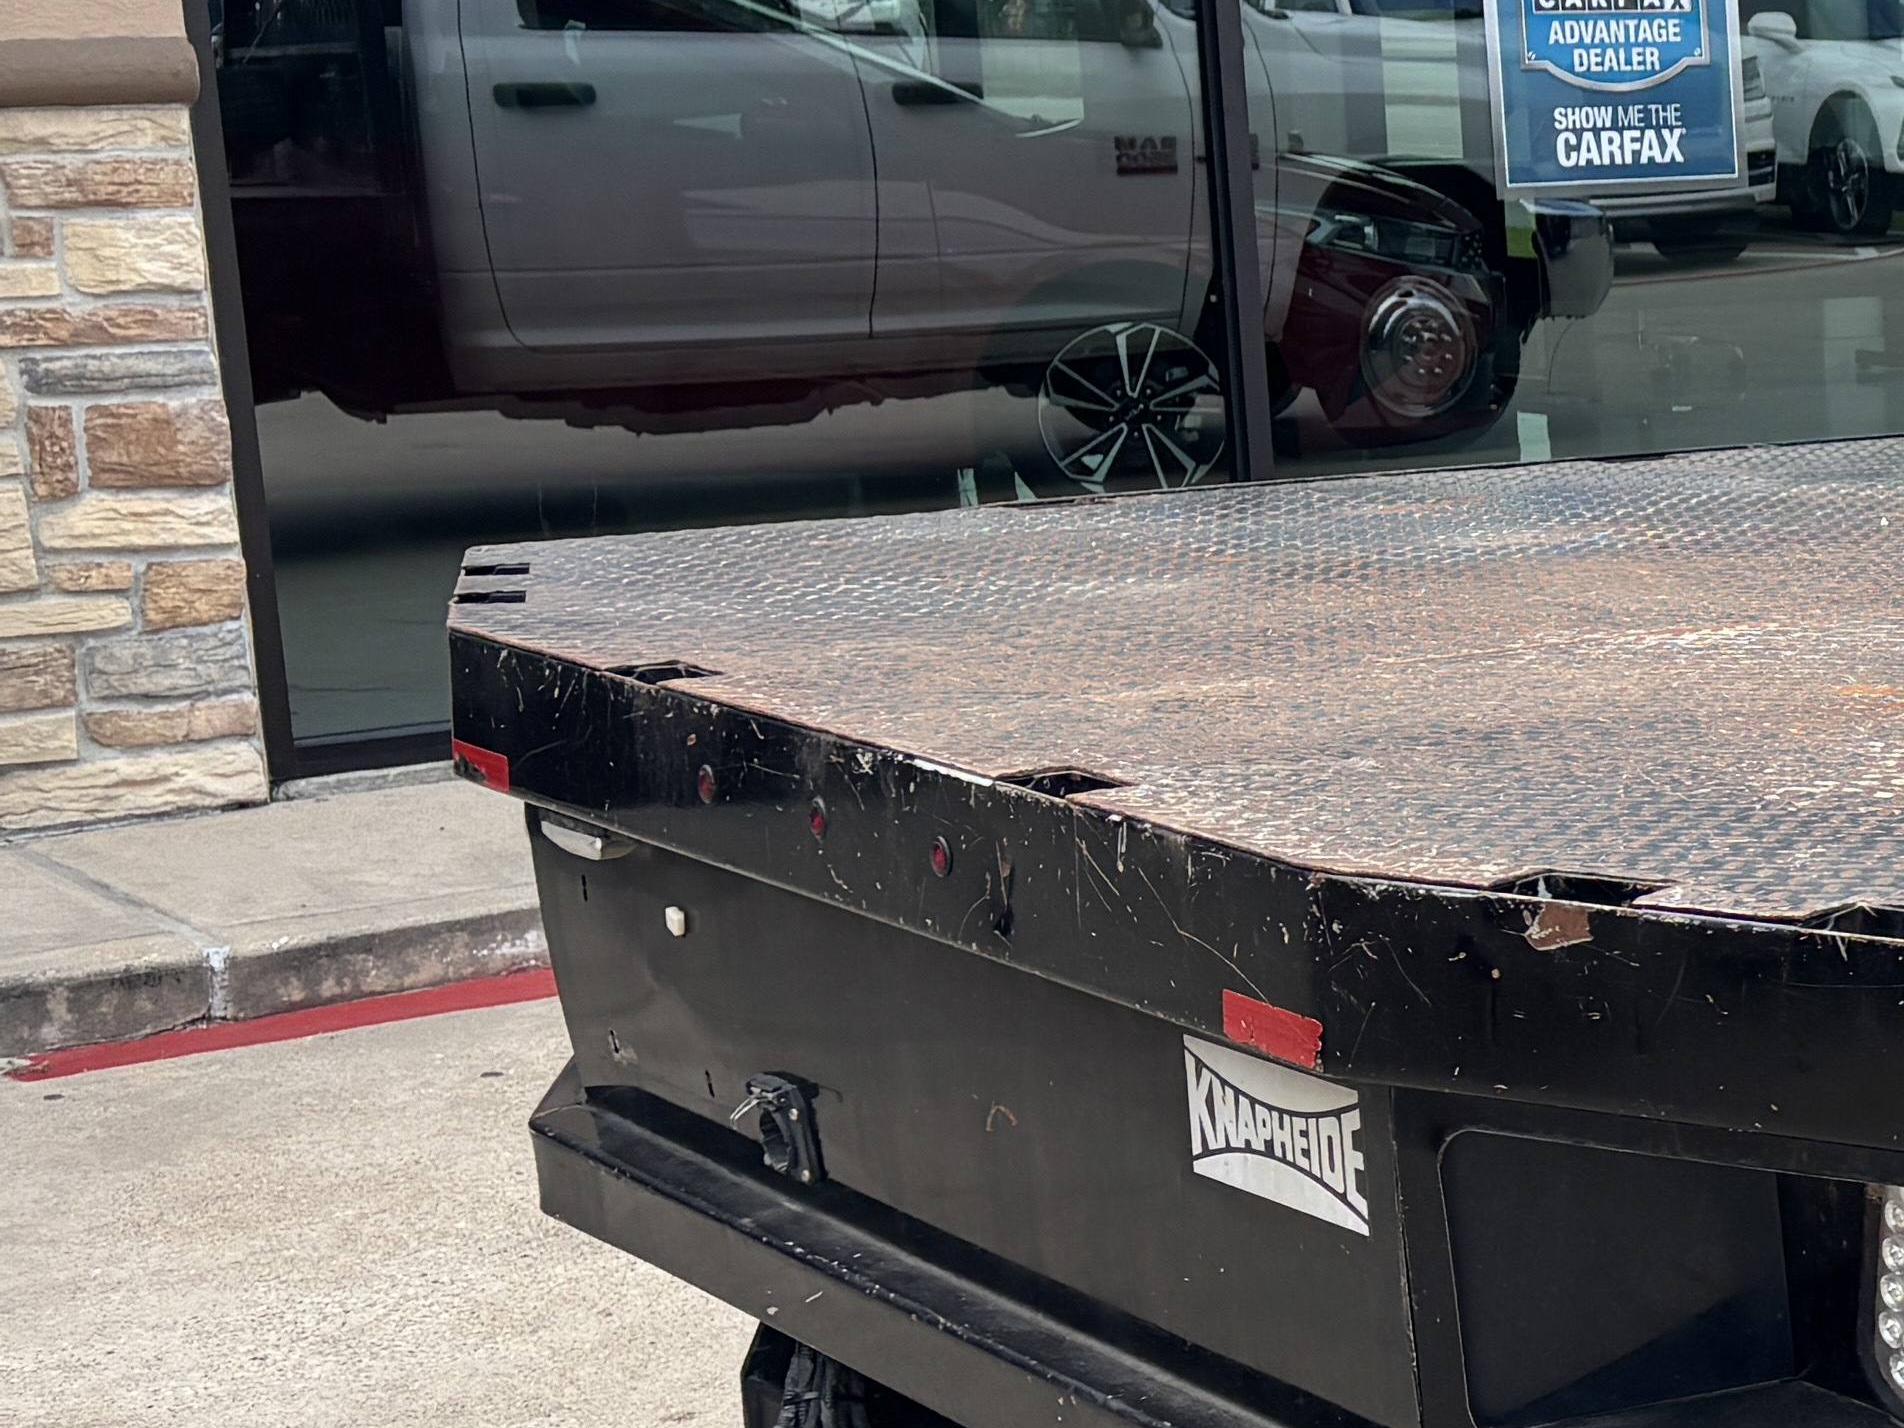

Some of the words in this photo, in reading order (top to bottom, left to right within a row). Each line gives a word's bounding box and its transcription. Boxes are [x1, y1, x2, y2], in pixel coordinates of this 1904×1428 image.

[1548, 18, 1682, 45] ADVANTAGE
[1573, 46, 1661, 72] DEALER
[1553, 106, 1613, 130] SHOW
[1618, 105, 1645, 128] ME
[1648, 104, 1683, 127] THE
[1184, 1048, 1369, 1220] KNAPHEIDE
